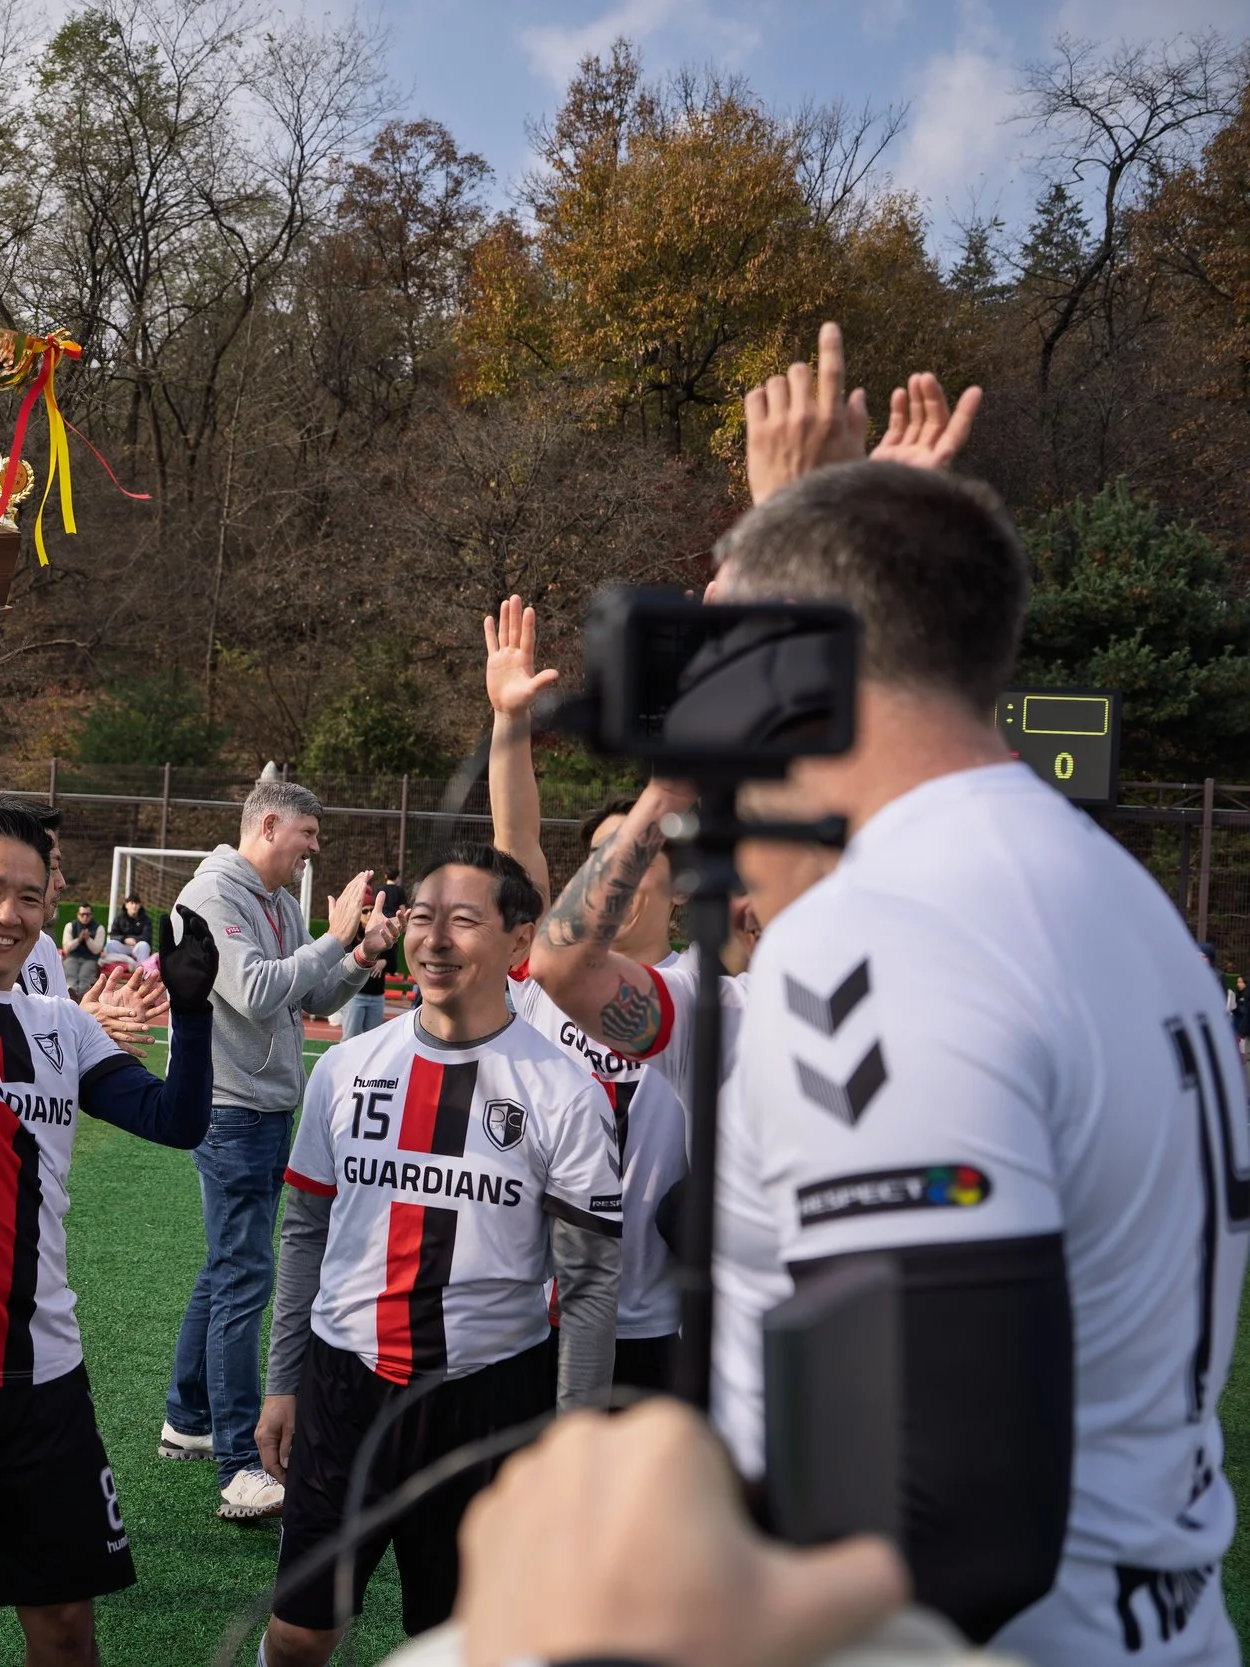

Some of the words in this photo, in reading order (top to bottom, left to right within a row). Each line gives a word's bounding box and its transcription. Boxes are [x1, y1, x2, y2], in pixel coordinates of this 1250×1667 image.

[1054, 752, 1074, 779] 0
[560, 1021, 641, 1073] GURD
[353, 1075, 399, 1089] hummel
[351, 1091, 394, 1141] 15
[344, 1155, 523, 1207] GUARDIANS
[100, 1465, 123, 1530] 8
